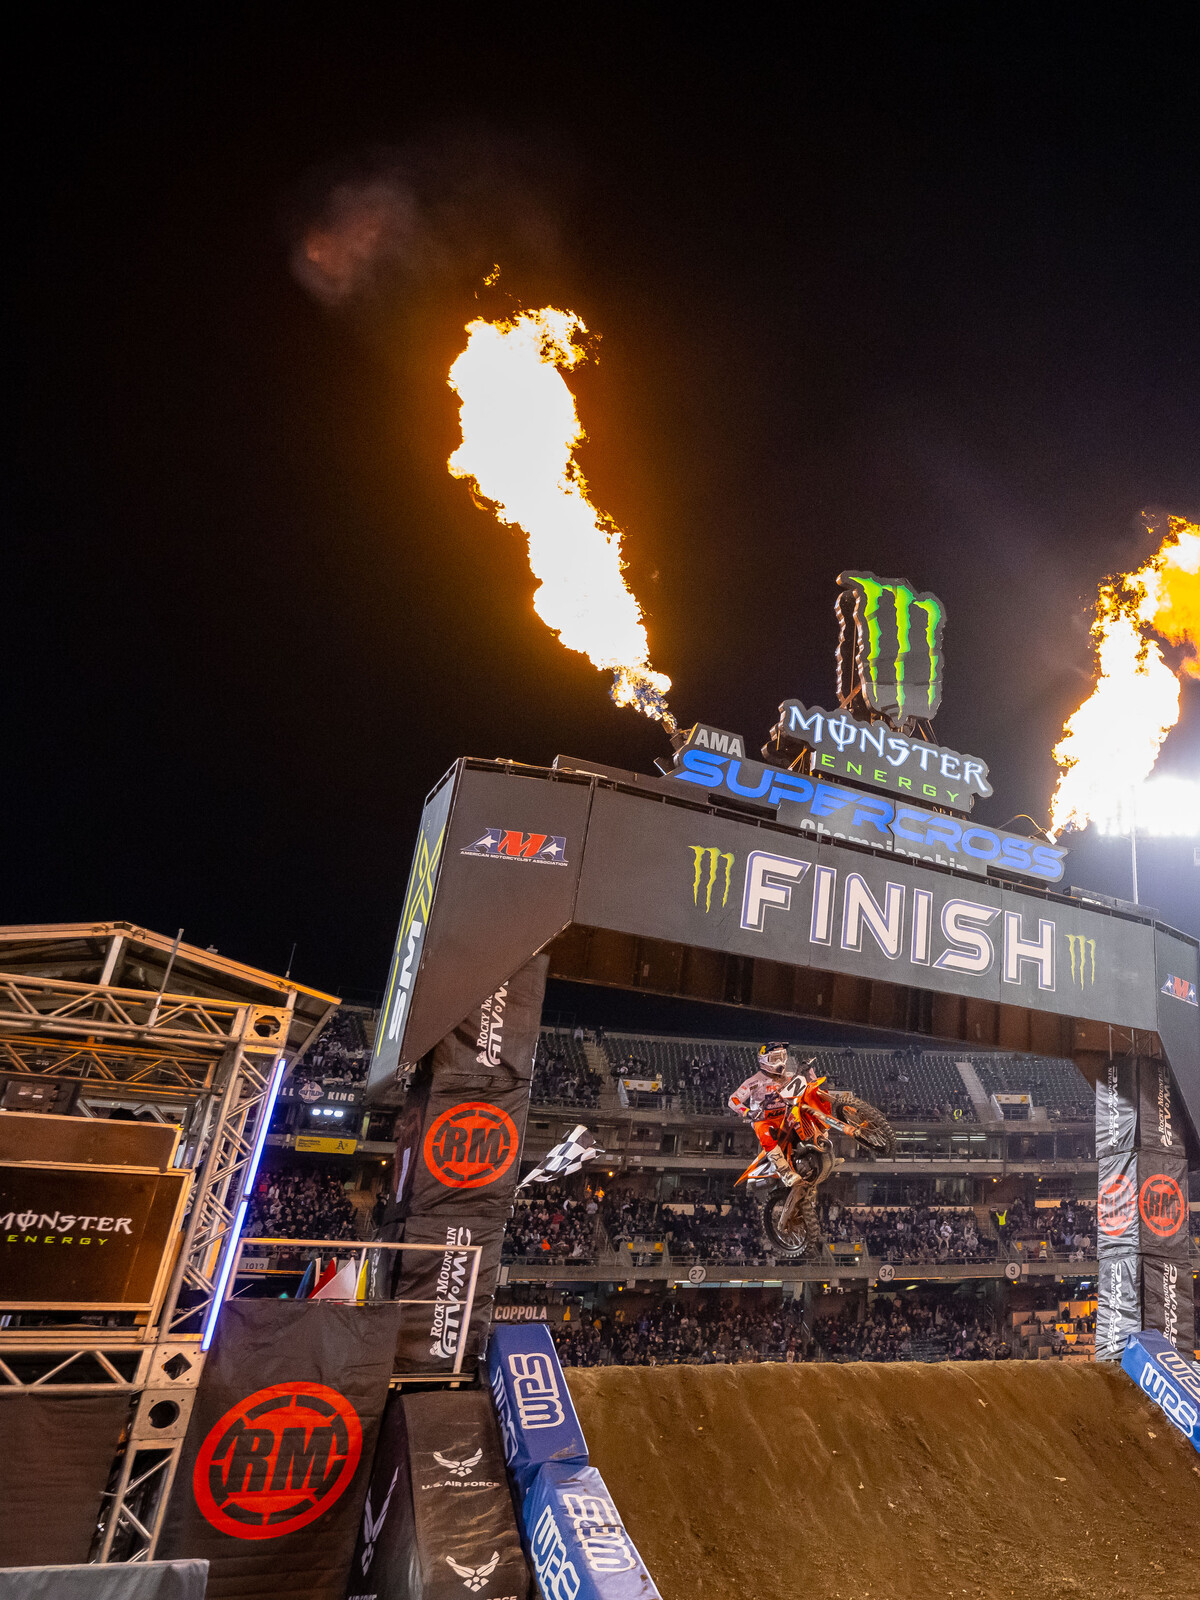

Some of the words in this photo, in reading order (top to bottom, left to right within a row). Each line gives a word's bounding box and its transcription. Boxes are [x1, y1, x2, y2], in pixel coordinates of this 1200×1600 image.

[693, 728, 743, 758] AMA
[788, 706, 990, 796] MONSTER
[821, 753, 960, 803] ENERGY
[674, 748, 1069, 879] SUPERCROSS
[460, 827, 569, 862] AMA
[460, 850, 490, 858] AMERICAN
[739, 849, 1056, 992] FINISH
[1160, 973, 1198, 1004] AMA
[476, 1012, 490, 1050] ROCKY
[327, 1091, 355, 1102] KING
[786, 1077, 806, 1097] 2
[7, 1234, 109, 1246] ENERGY
[690, 1269, 704, 1280] 27
[881, 1268, 893, 1278] 34
[1009, 1266, 1016, 1276] 9
[494, 1305, 548, 1320] COPPOLA
[508, 1352, 565, 1430] WPS
[1139, 1362, 1198, 1438] WPS
